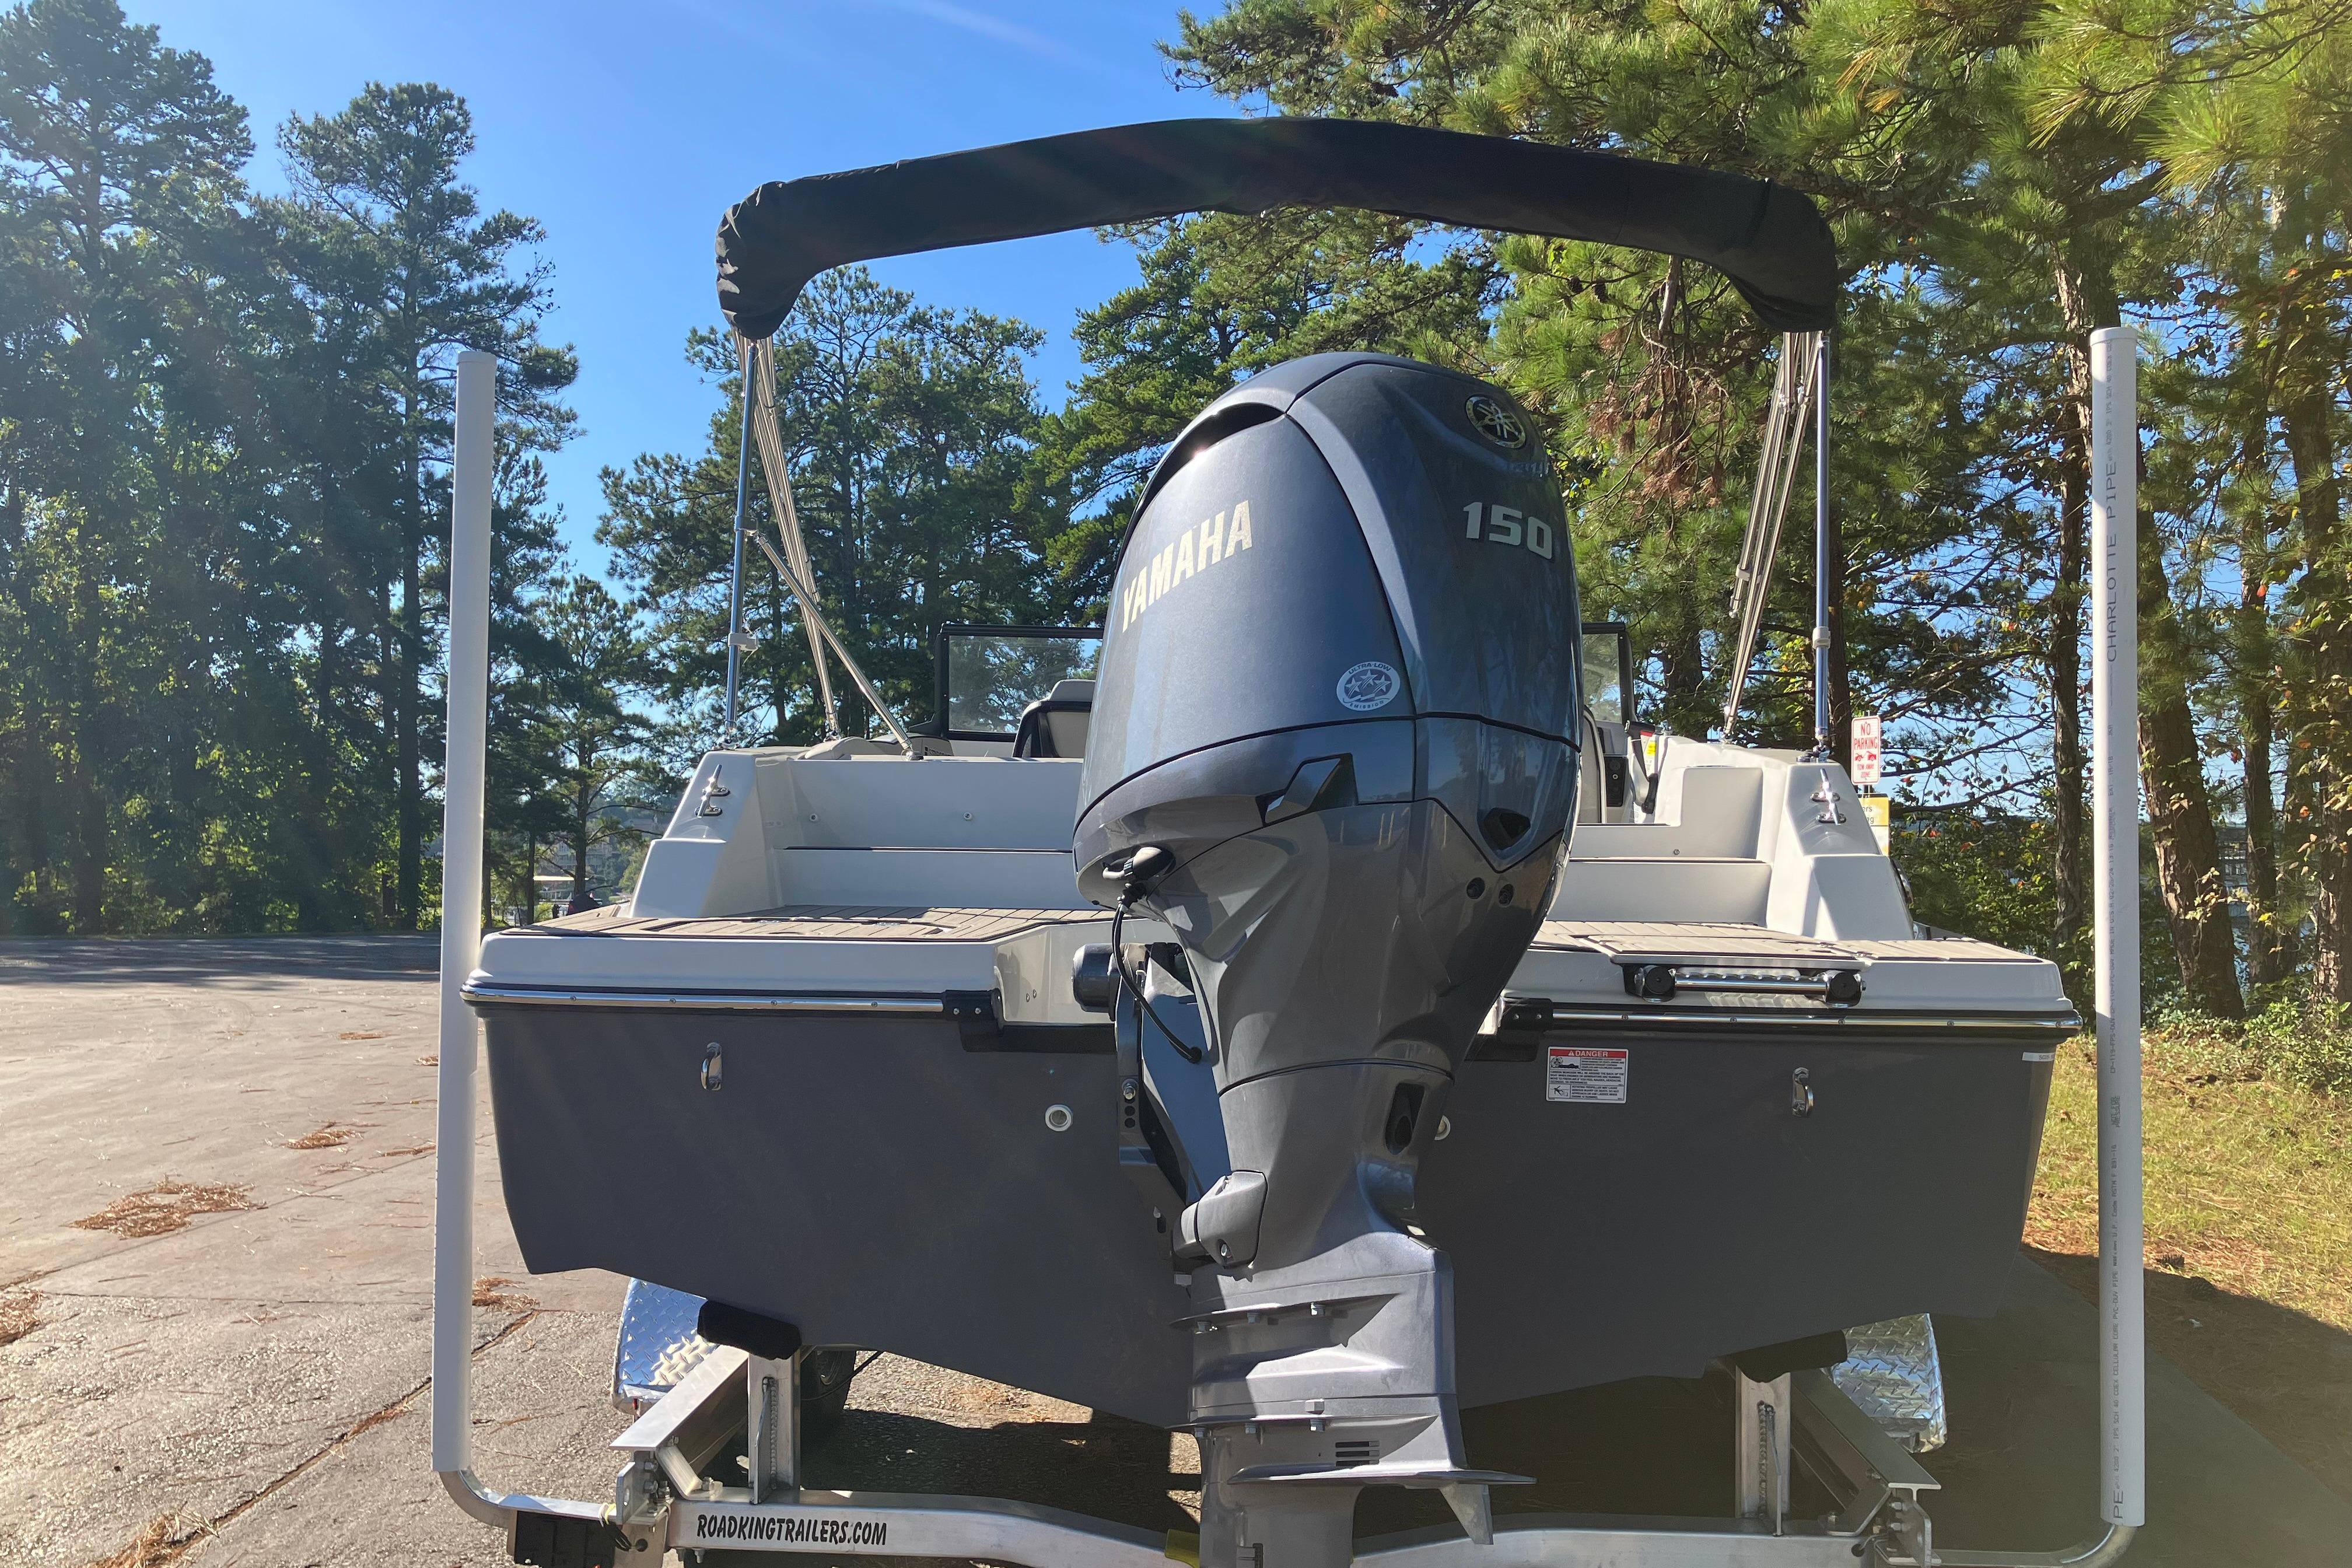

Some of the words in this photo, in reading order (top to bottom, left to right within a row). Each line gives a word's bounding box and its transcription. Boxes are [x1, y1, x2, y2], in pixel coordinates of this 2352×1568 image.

[2106, 463, 2116, 518] PIPE
[1463, 502, 1552, 559] 150
[1122, 500, 1254, 633] YAMAHA
[2107, 533, 2116, 662] CHARLOTTE
[1350, 701, 1384, 709] EMISSION
[1854, 737, 1878, 750] PARKING
[1861, 723, 1871, 736] NO
[696, 1514, 887, 1545] ROADKINGTRAILERS.COM
